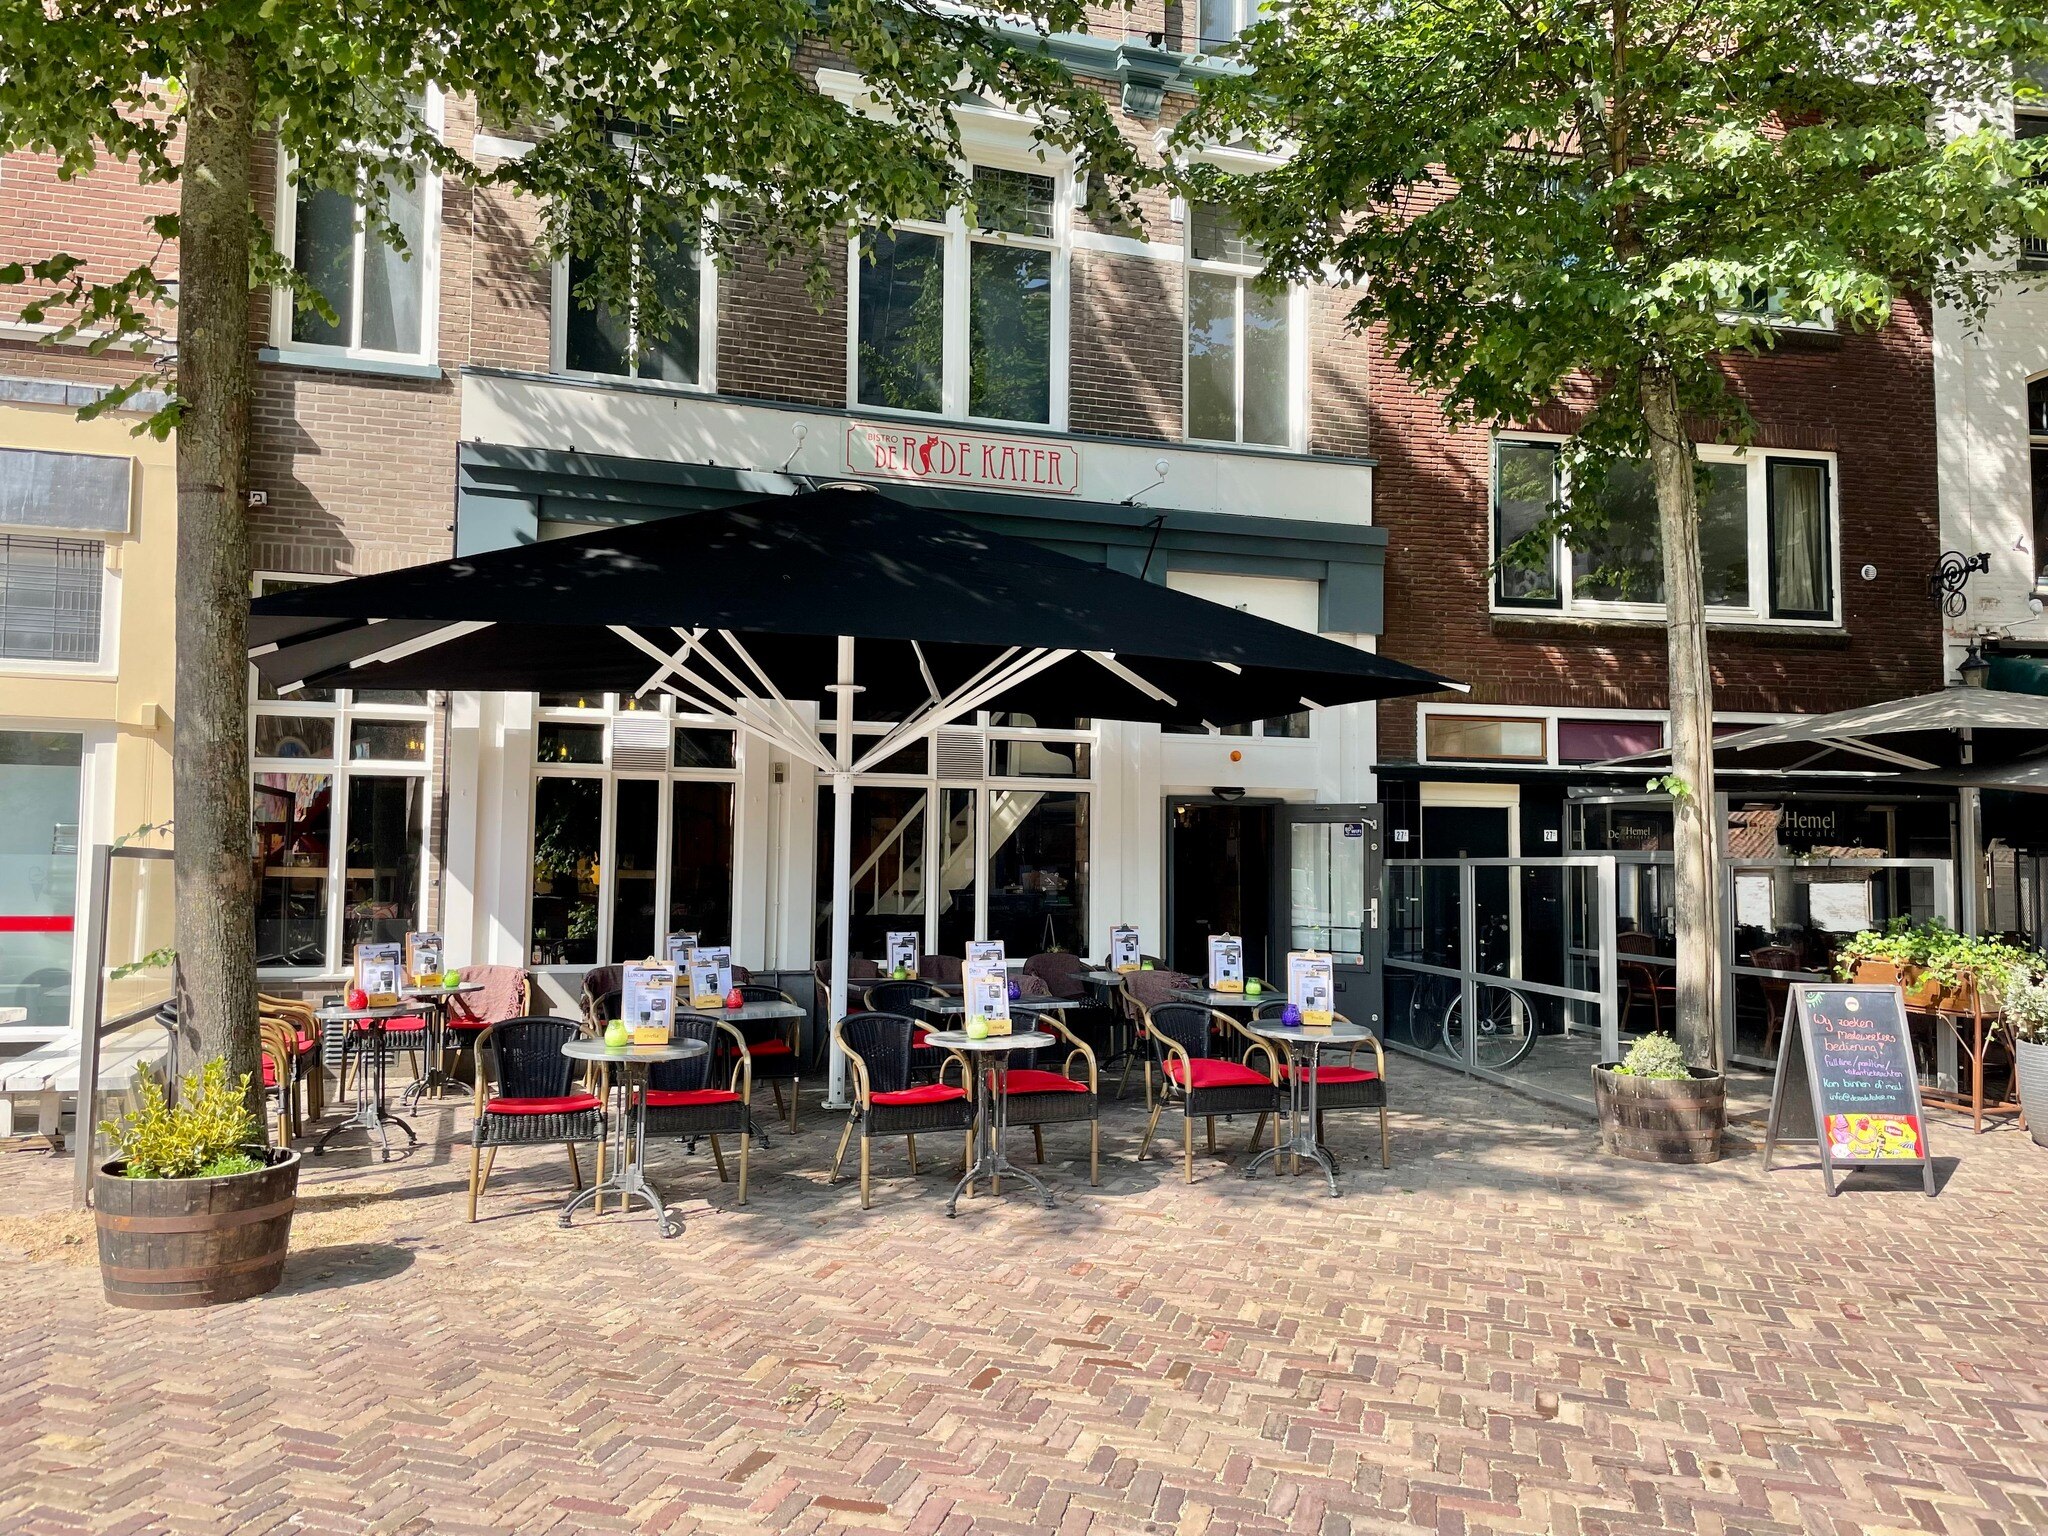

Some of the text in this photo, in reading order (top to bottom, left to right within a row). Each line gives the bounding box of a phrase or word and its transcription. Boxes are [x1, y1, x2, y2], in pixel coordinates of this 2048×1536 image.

[867, 432, 899, 444] BISTRO
[875, 444, 897, 470] DE
[981, 444, 1063, 486] KATER
[1785, 811, 1835, 829] Hemel
[1607, 826, 1651, 839] De Hemel
[1838, 1017, 1874, 1028] zoeken
[1842, 1078, 1871, 1088] binnen
[1875, 1080, 1884, 1090] of
